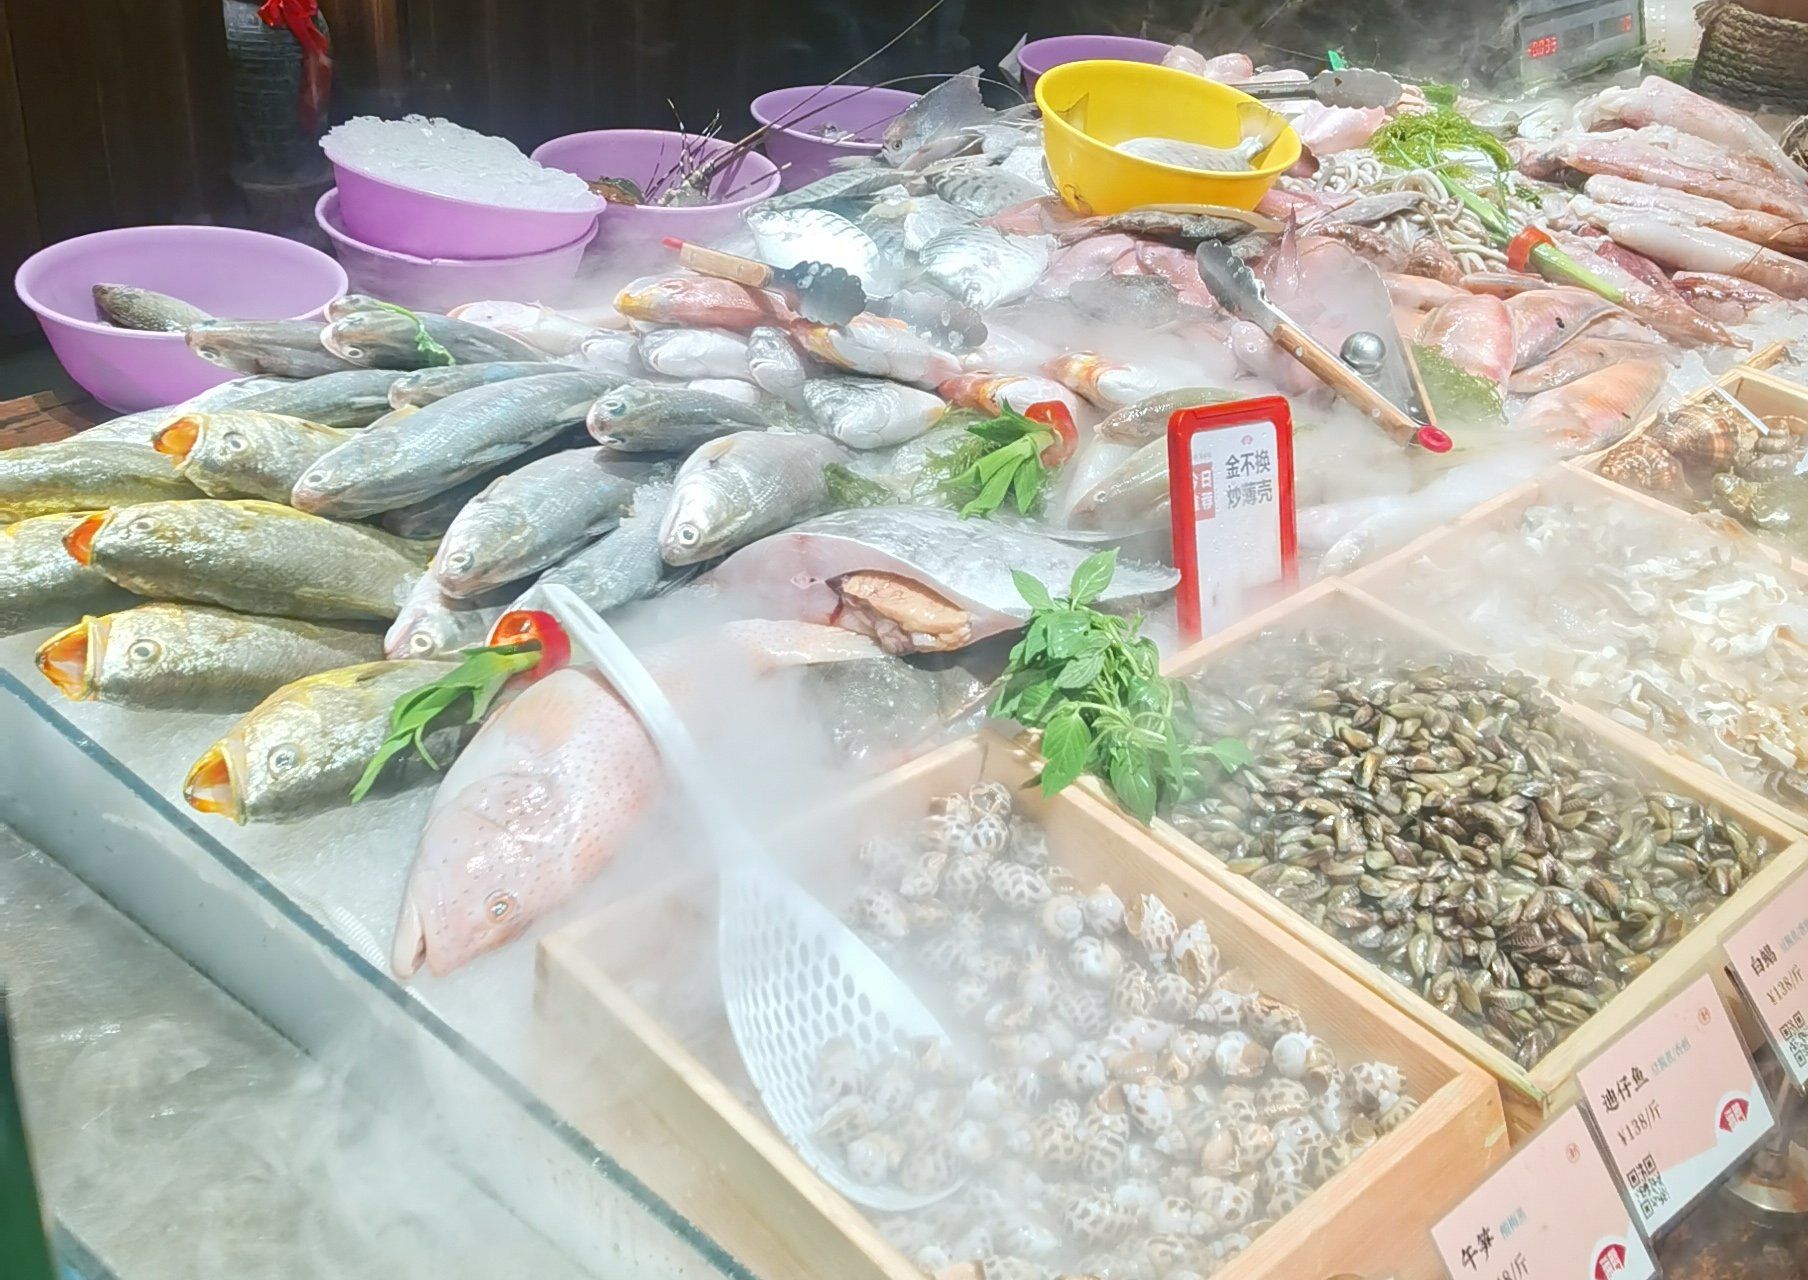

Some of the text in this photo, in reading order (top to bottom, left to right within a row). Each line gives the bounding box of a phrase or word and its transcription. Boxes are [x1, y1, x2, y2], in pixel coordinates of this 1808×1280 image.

[1225, 450, 1271, 480] 金不换
[1226, 479, 1272, 510] 炒薄壳
[1600, 1066, 1649, 1113] 迪仔鱼
